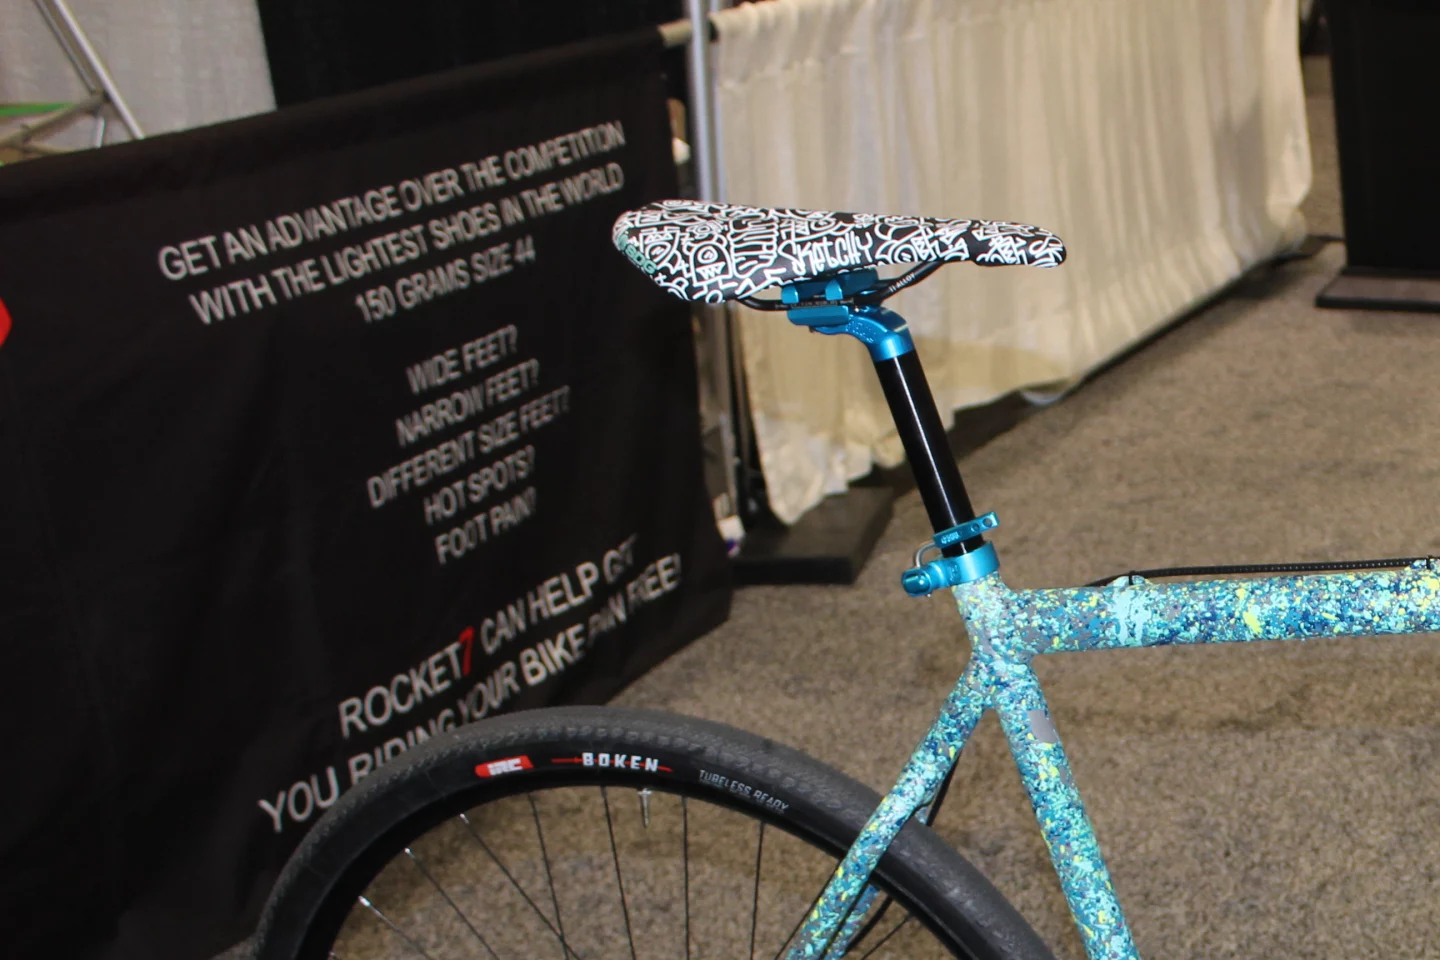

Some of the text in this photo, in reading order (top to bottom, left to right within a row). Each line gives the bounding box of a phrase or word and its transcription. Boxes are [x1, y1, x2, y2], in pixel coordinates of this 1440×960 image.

[158, 120, 625, 280] GET AN ADVANTAGE OVER THE COMPETITION
[189, 161, 624, 325] WITH THE LIGHTEST SHOES IN THE WORLD
[355, 234, 537, 333] 150 GRAMS SIZE 44
[396, 357, 540, 448] NARROW FEET?
[405, 324, 519, 395] WIDE FEET?
[367, 384, 571, 509] DIFFERENT SIZE FEET?
[423, 444, 536, 526] HOT SPOTS?
[434, 511, 488, 565] FOOT
[479, 597, 528, 655] CAN
[529, 561, 600, 622] HELP
[257, 766, 341, 833] YOU
[458, 660, 522, 724] YOUR
[520, 624, 586, 687] BIKE
[582, 752, 659, 773] BOKEN
[700, 769, 789, 811] TUBELESS READY
